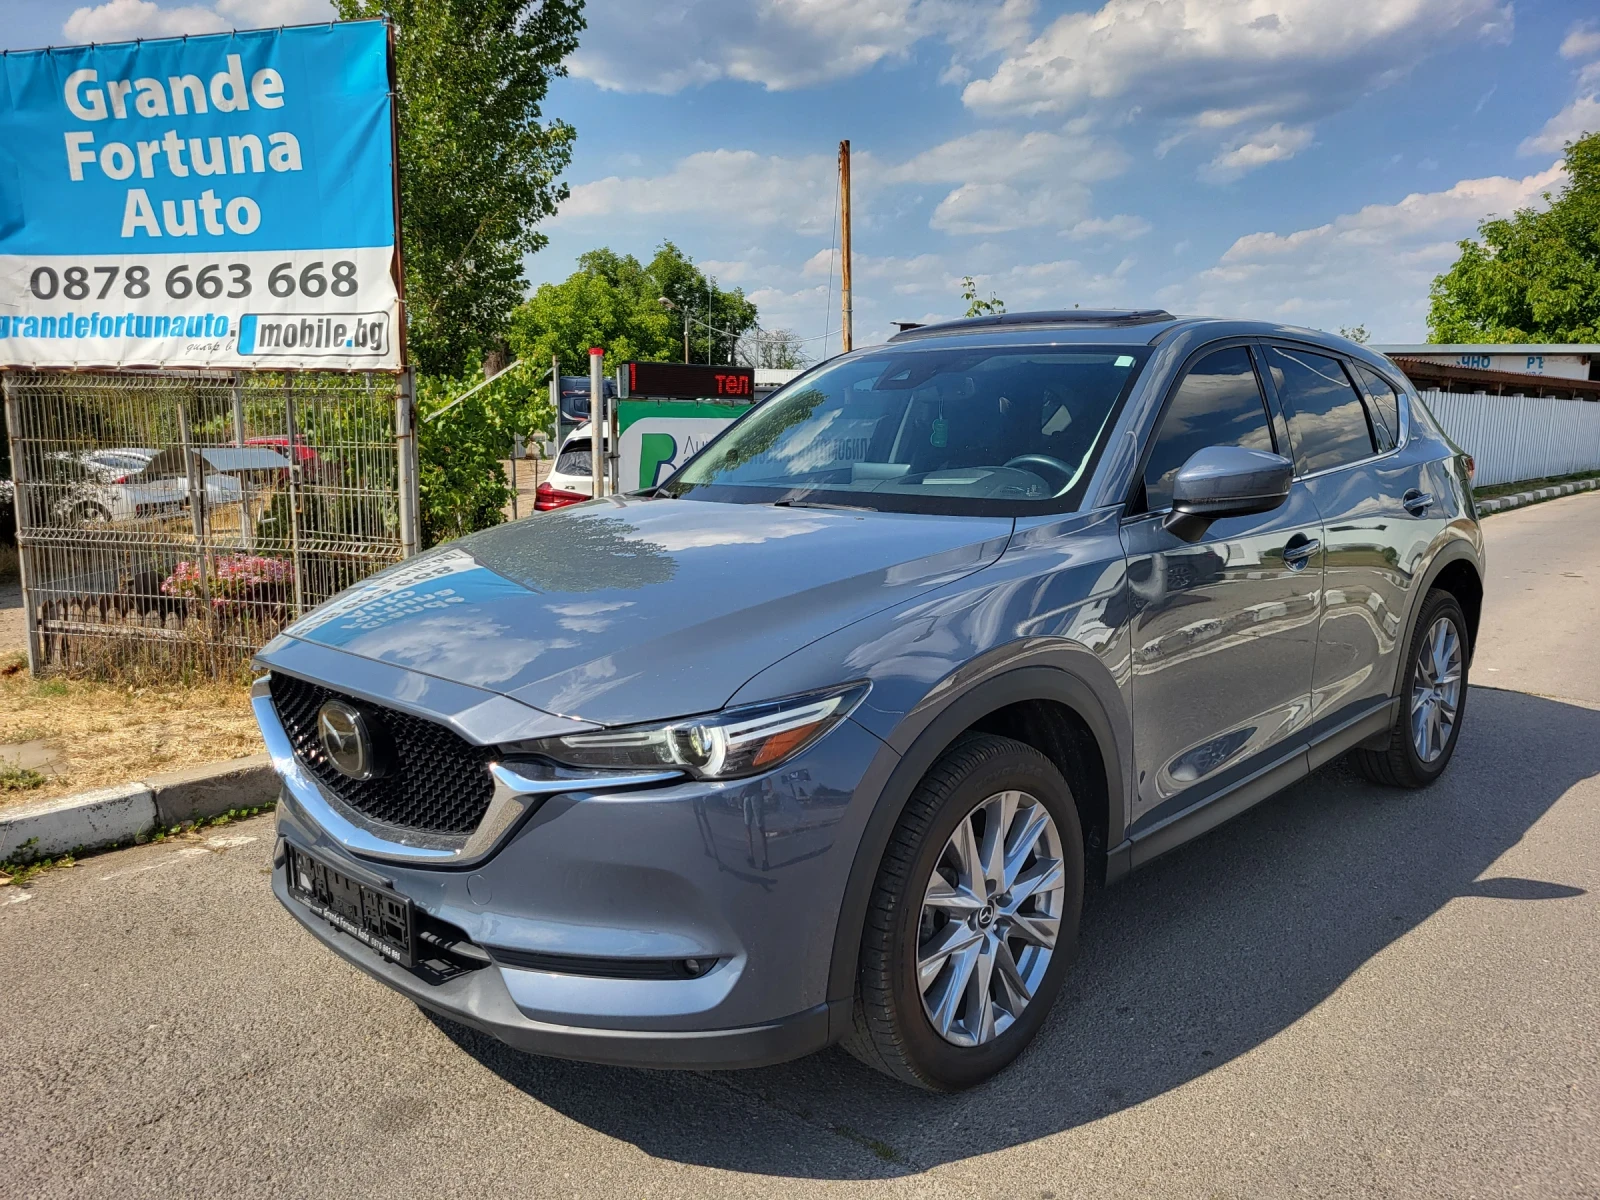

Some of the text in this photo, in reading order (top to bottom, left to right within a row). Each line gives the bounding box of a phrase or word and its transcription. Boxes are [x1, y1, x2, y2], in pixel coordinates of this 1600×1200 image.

[64, 54, 285, 122] Grande
[64, 130, 303, 181] Fortuna
[120, 188, 262, 238] Auto
[30, 261, 358, 300] 0878 663 668
[258, 318, 384, 351] mobile.bg
[1456, 356, 1491, 369] ЧНО
